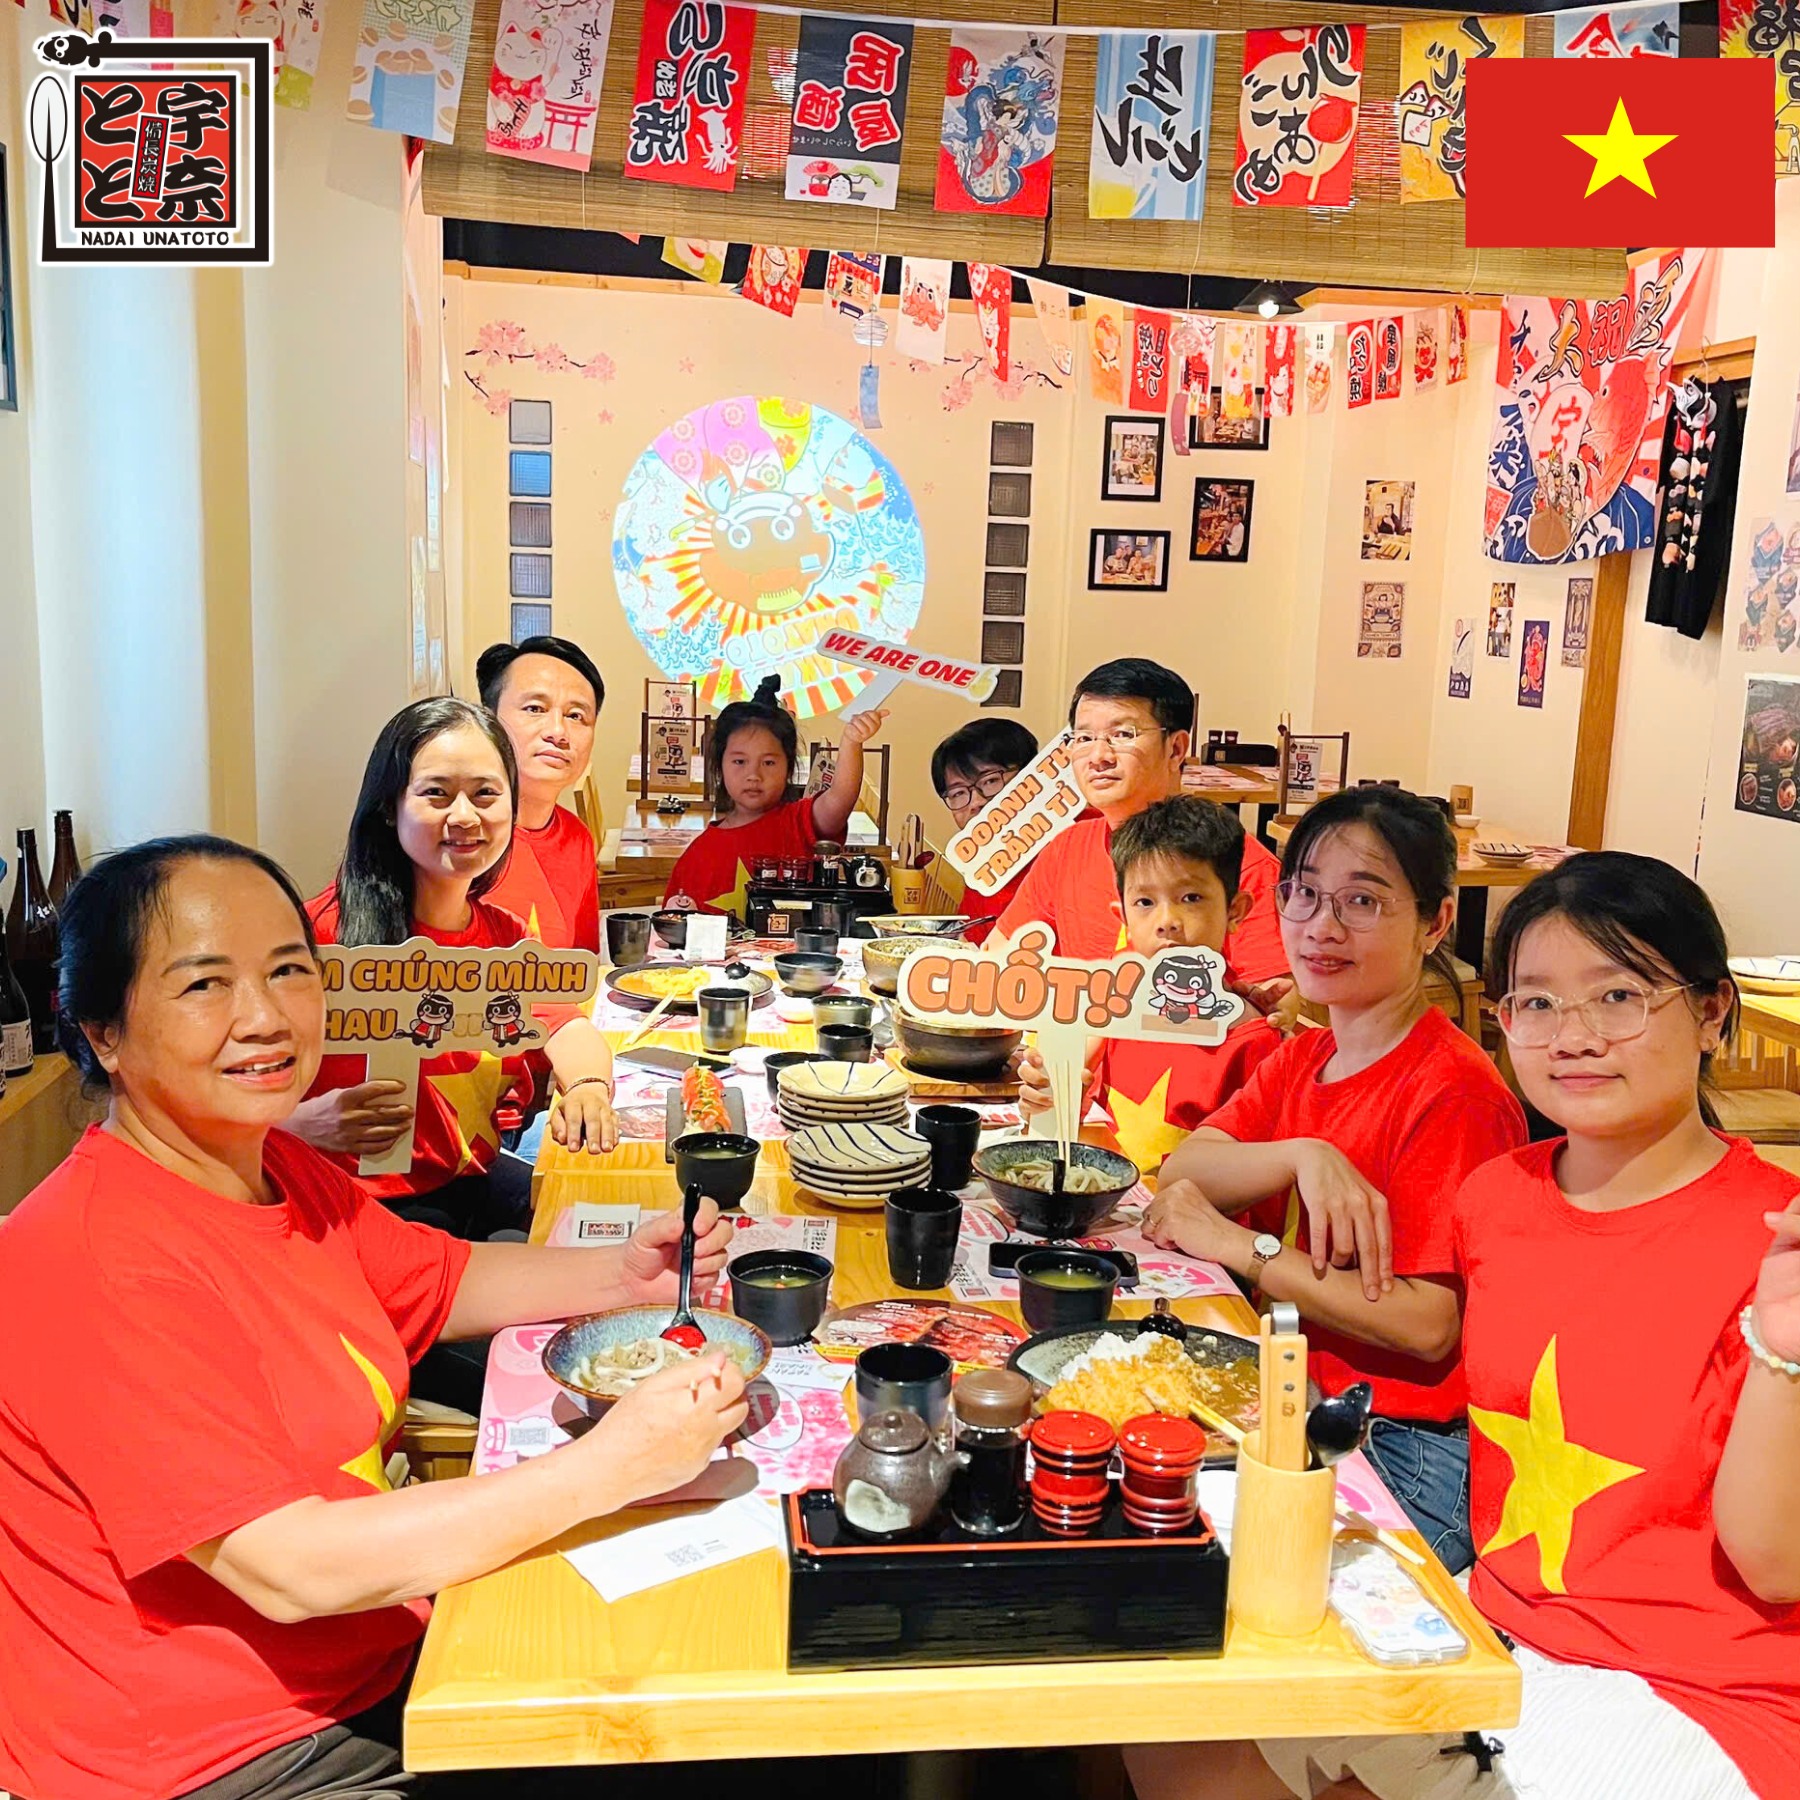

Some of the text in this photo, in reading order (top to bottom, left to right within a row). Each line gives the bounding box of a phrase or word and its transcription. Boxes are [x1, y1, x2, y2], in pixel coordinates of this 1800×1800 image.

[824, 633, 977, 686] WE ARE ONE
[954, 738, 1073, 863] DOANH TH
[973, 812, 1053, 887] TRĂM
[351, 949, 483, 993] CHÚNG
[485, 952, 588, 993] MÌNH
[907, 930, 1146, 1029] CHỐT!!
[324, 1007, 399, 1041] HAU
